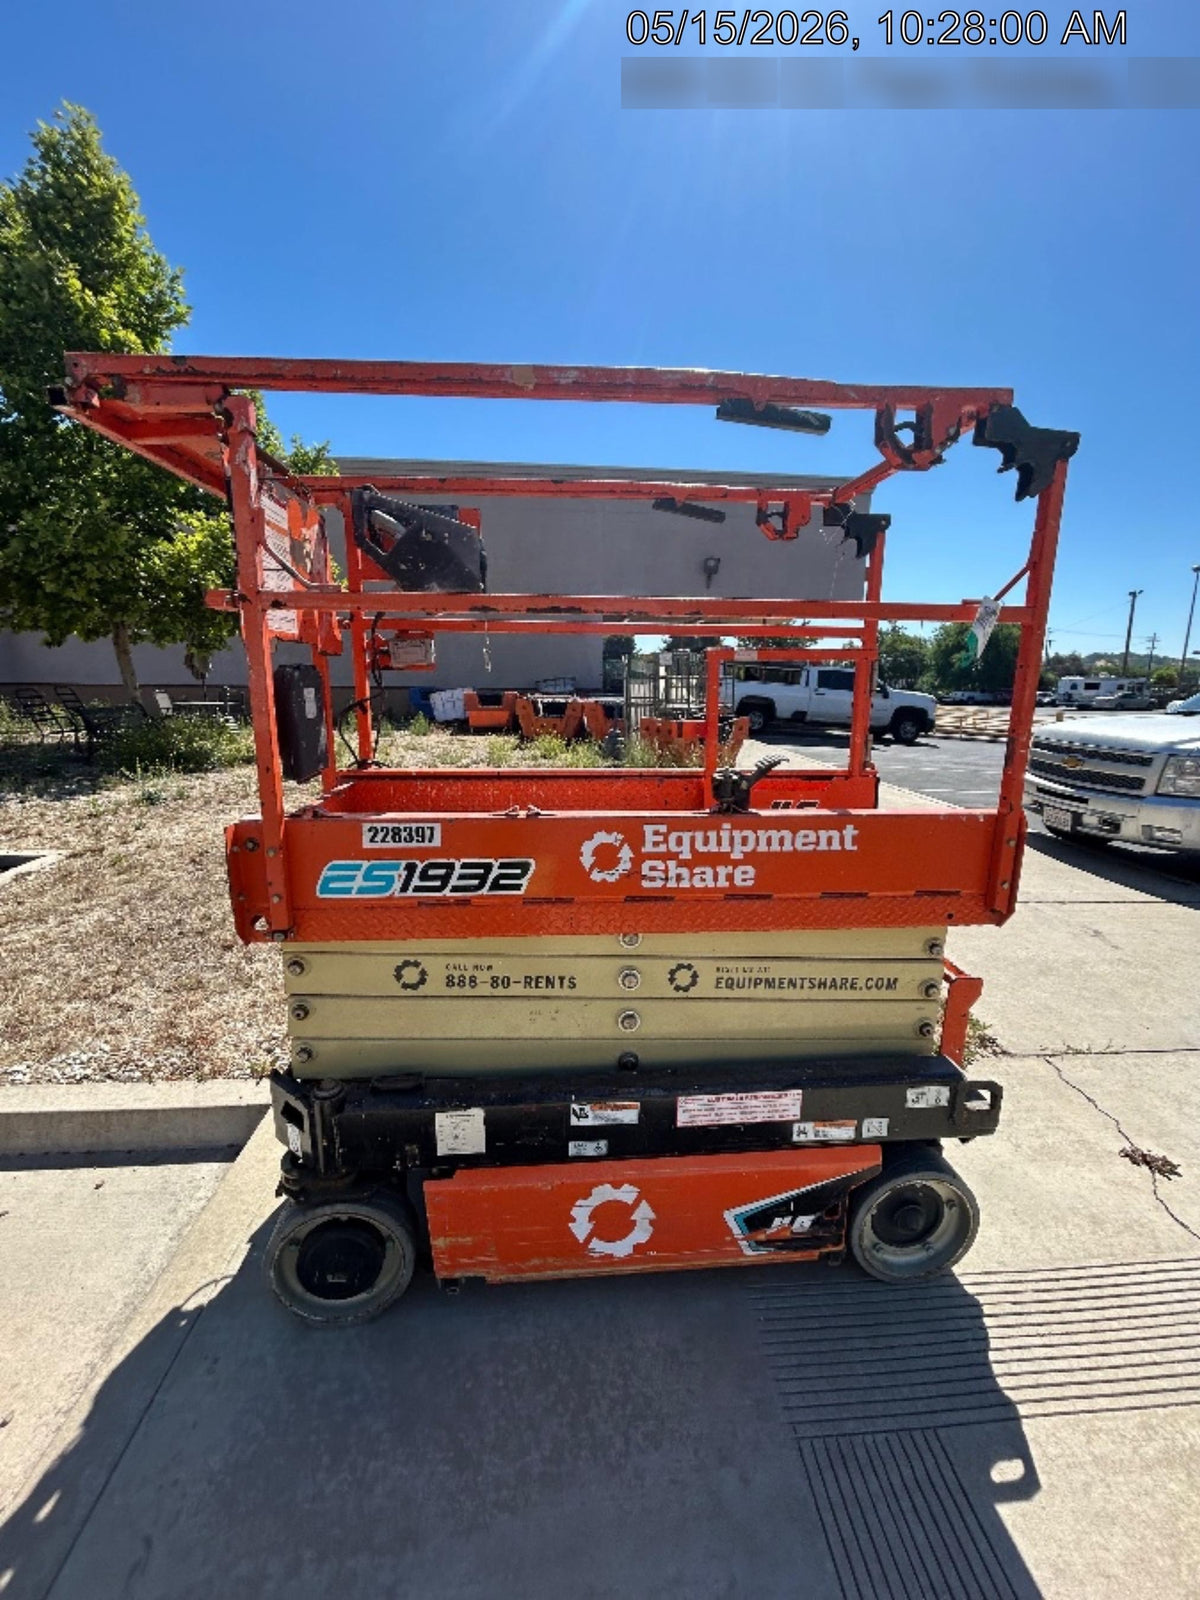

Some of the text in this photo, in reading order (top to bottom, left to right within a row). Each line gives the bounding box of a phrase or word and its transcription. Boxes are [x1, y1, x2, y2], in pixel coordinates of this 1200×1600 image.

[367, 825, 436, 845] 228397
[641, 823, 858, 859] Equipment
[316, 859, 536, 898] ES1932
[641, 859, 757, 889] Share
[445, 963, 468, 972] CALL
[445, 973, 577, 989] 888-80-RENTS
[714, 976, 899, 991] EQUIPMENTSHARE.COM
